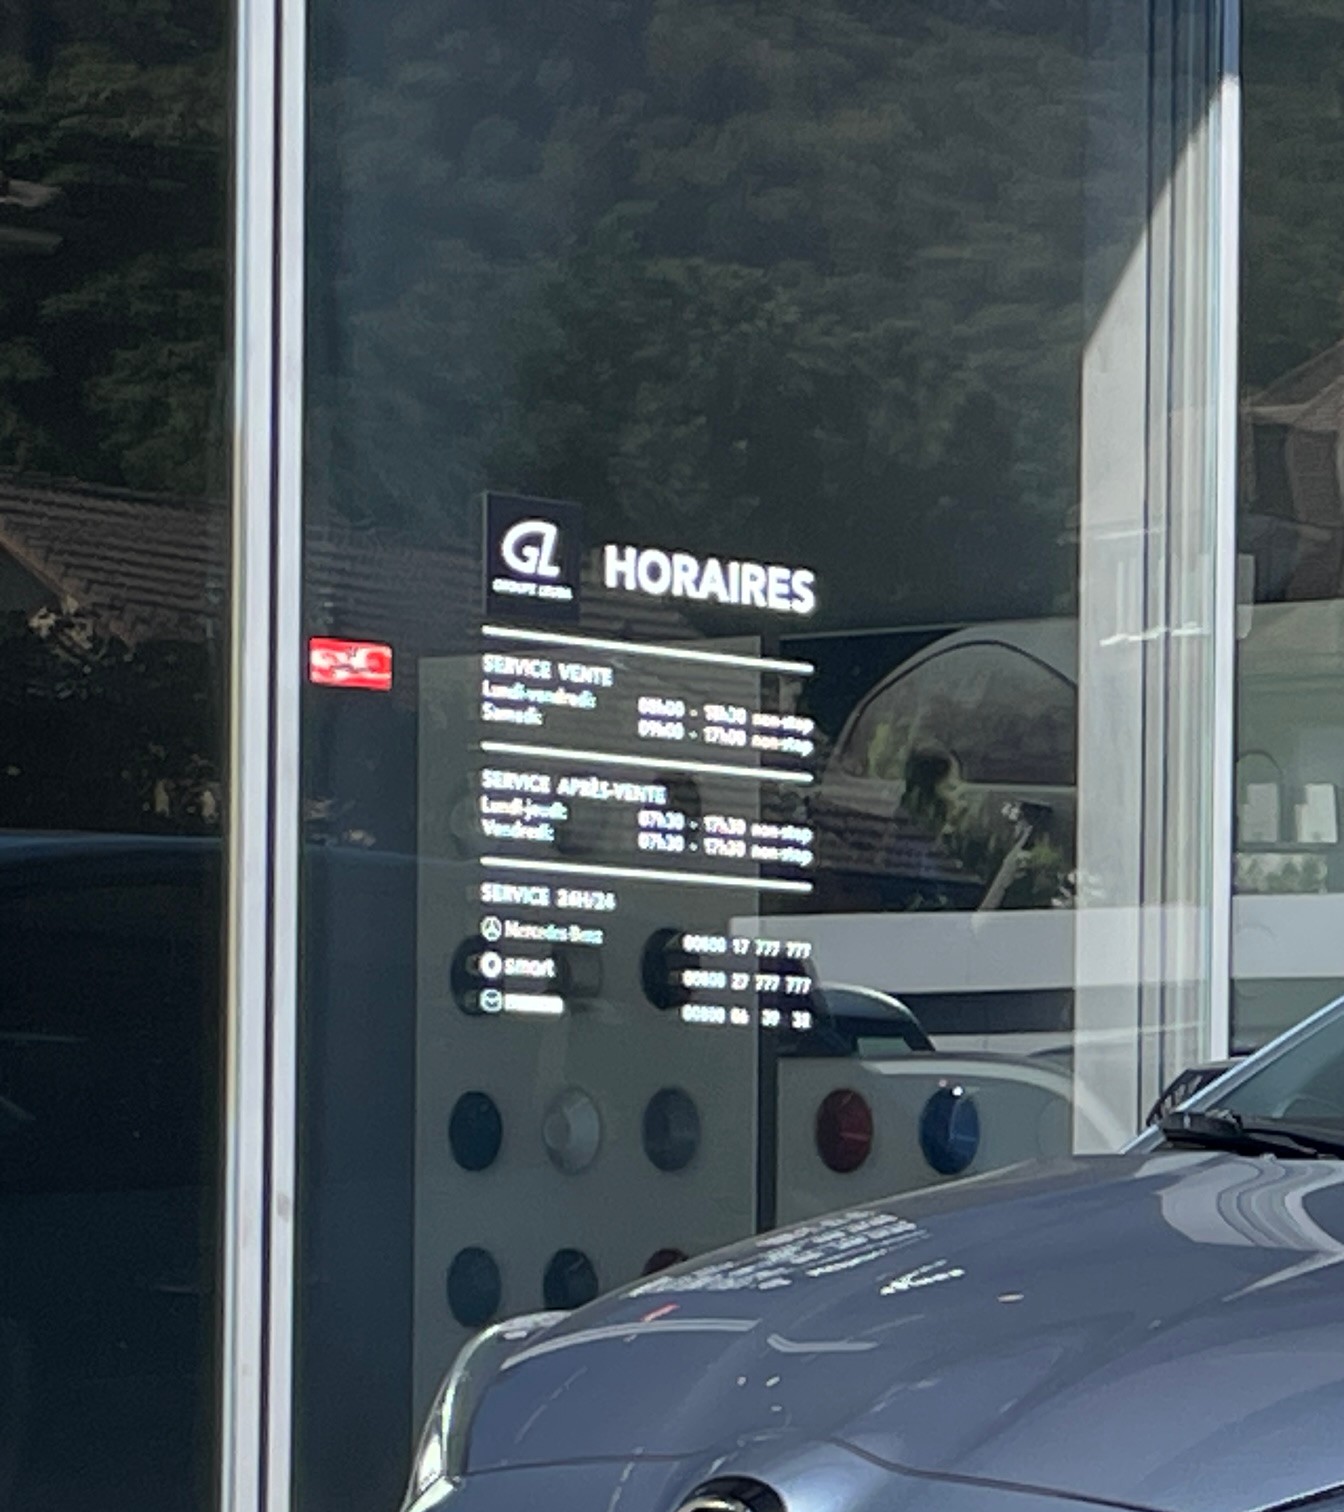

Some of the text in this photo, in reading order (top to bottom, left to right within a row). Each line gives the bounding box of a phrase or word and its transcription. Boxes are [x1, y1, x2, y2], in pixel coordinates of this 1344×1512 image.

[605, 545, 815, 613] HORAIRES
[482, 654, 613, 687] SERVICE VENTE
[482, 769, 666, 805] SERVICE APRÈS-VENTE
[481, 883, 550, 906] SERVICE
[504, 920, 603, 944] Mercedes-Benz
[504, 958, 555, 977] smart
